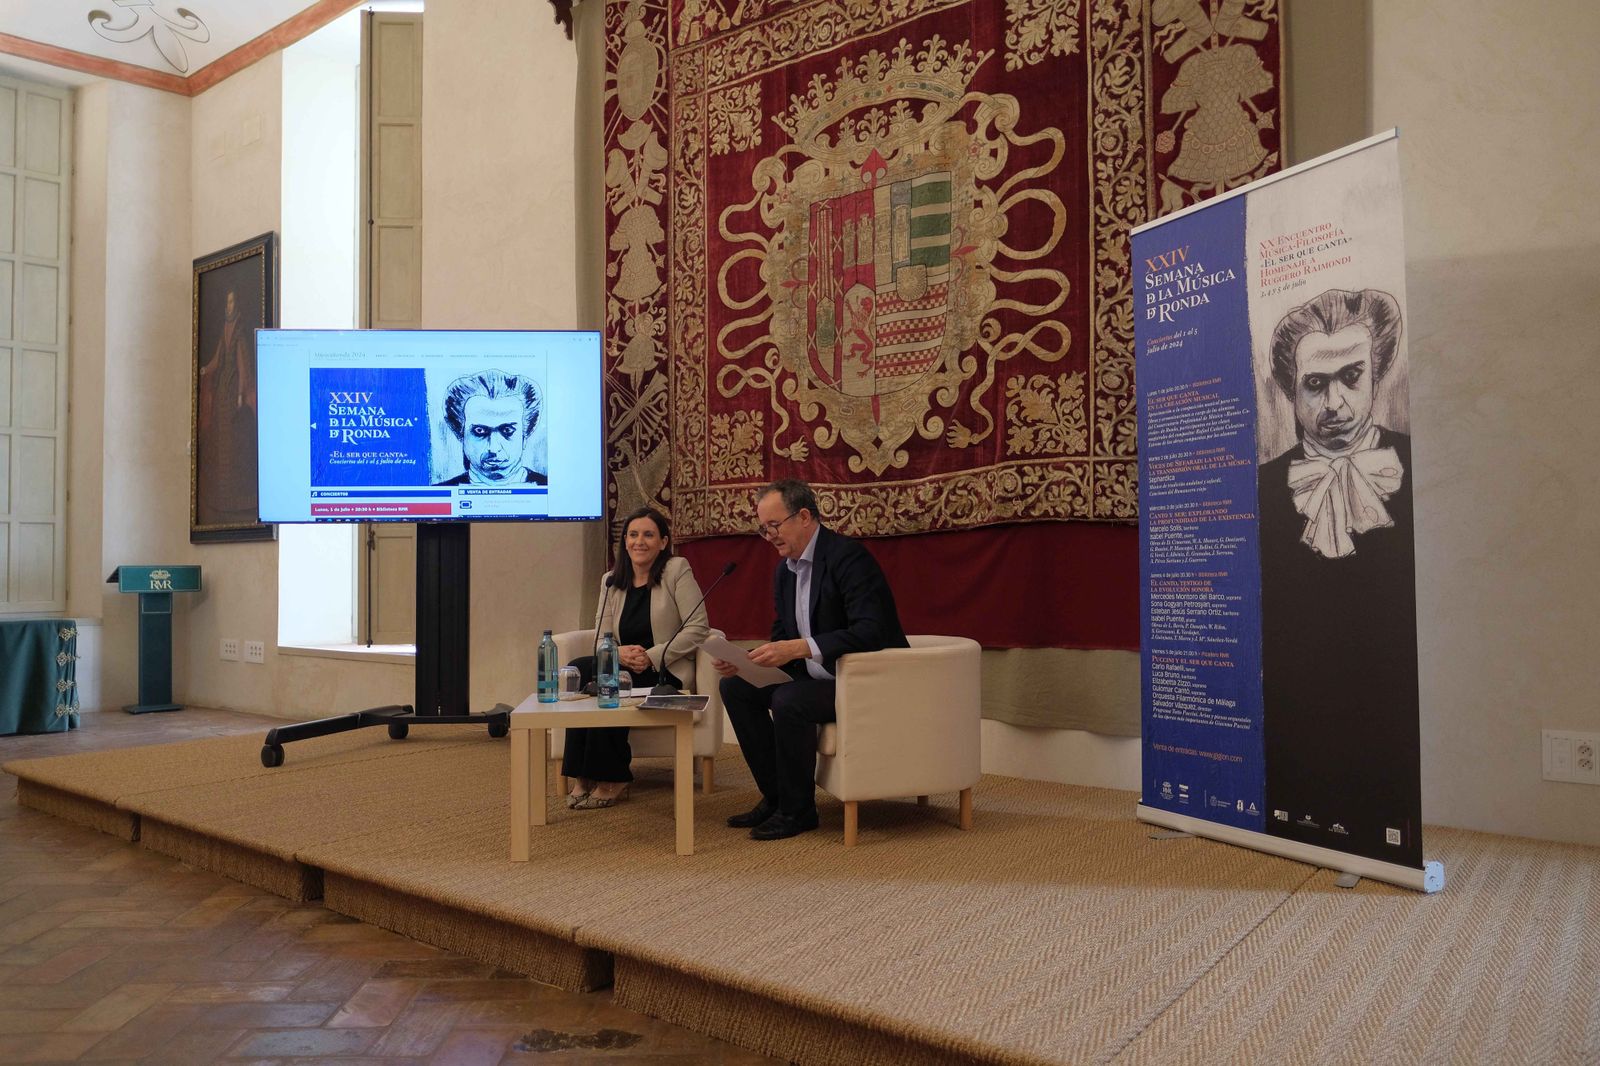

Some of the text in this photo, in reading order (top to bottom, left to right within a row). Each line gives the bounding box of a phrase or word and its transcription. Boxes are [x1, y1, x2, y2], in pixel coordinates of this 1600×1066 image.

[1146, 246, 1189, 275] XXIV
[1279, 254, 1294, 263] SER
[1297, 247, 1314, 258] QUE
[1292, 279, 1307, 289] julio
[1159, 288, 1172, 300] LA
[1147, 336, 1173, 345] Conciertos
[1147, 345, 1160, 356] julio
[330, 392, 372, 404] XXIV
[342, 418, 357, 427] LA
[150, 580, 173, 590] RMR
